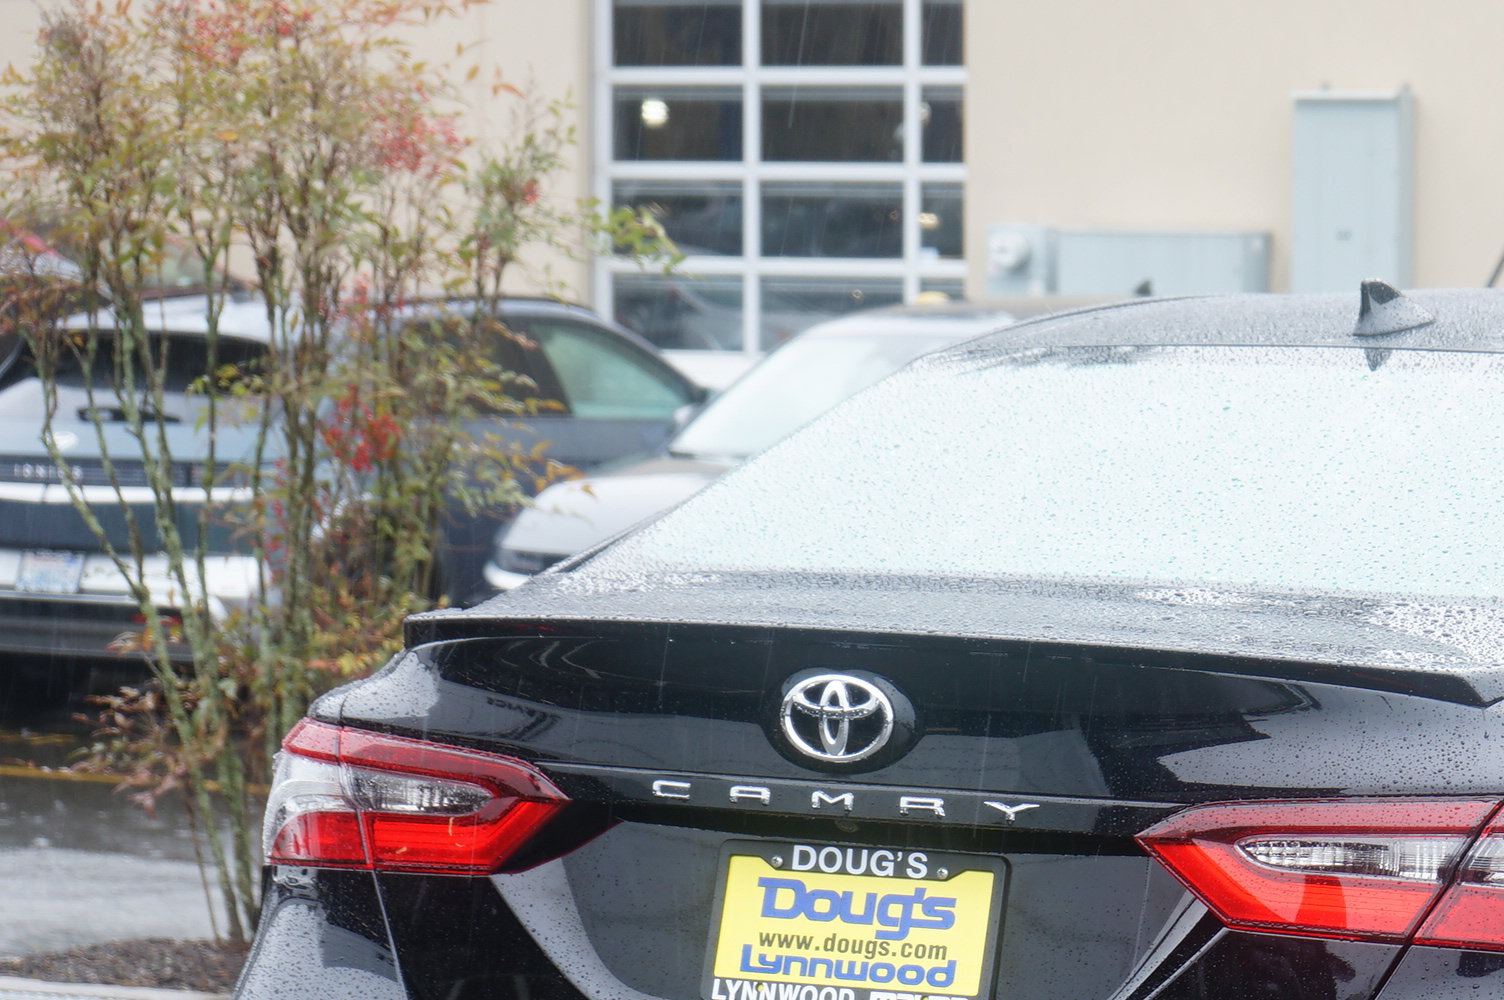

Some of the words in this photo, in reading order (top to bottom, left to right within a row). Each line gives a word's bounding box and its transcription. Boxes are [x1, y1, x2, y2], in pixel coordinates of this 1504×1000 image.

[652, 779, 1041, 825] CAMRY
[791, 844, 928, 879] DOUG'S
[757, 876, 958, 941] Doug's
[739, 944, 957, 988] Lynnwood
[758, 931, 948, 961] www.dougs.com
